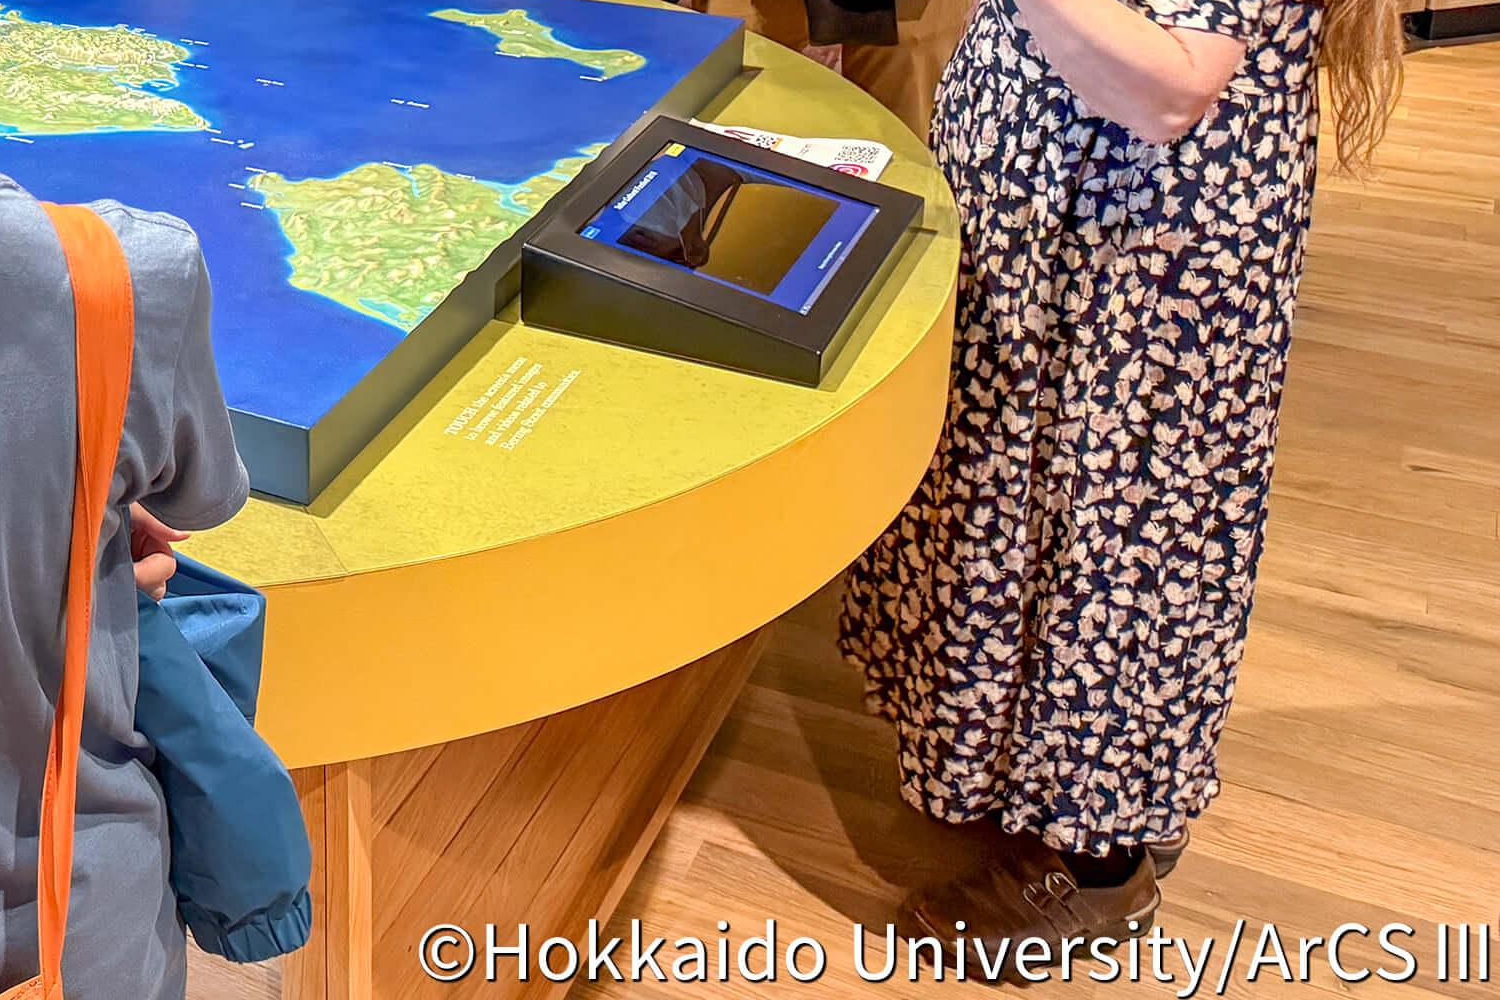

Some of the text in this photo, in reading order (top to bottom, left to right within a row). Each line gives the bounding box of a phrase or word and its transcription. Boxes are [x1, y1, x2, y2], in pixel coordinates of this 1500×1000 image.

[444, 407, 479, 436] TOUCH
[484, 430, 502, 446] and
[515, 387, 541, 411] related
[499, 426, 532, 451] Bering
[520, 407, 547, 428] Strait
